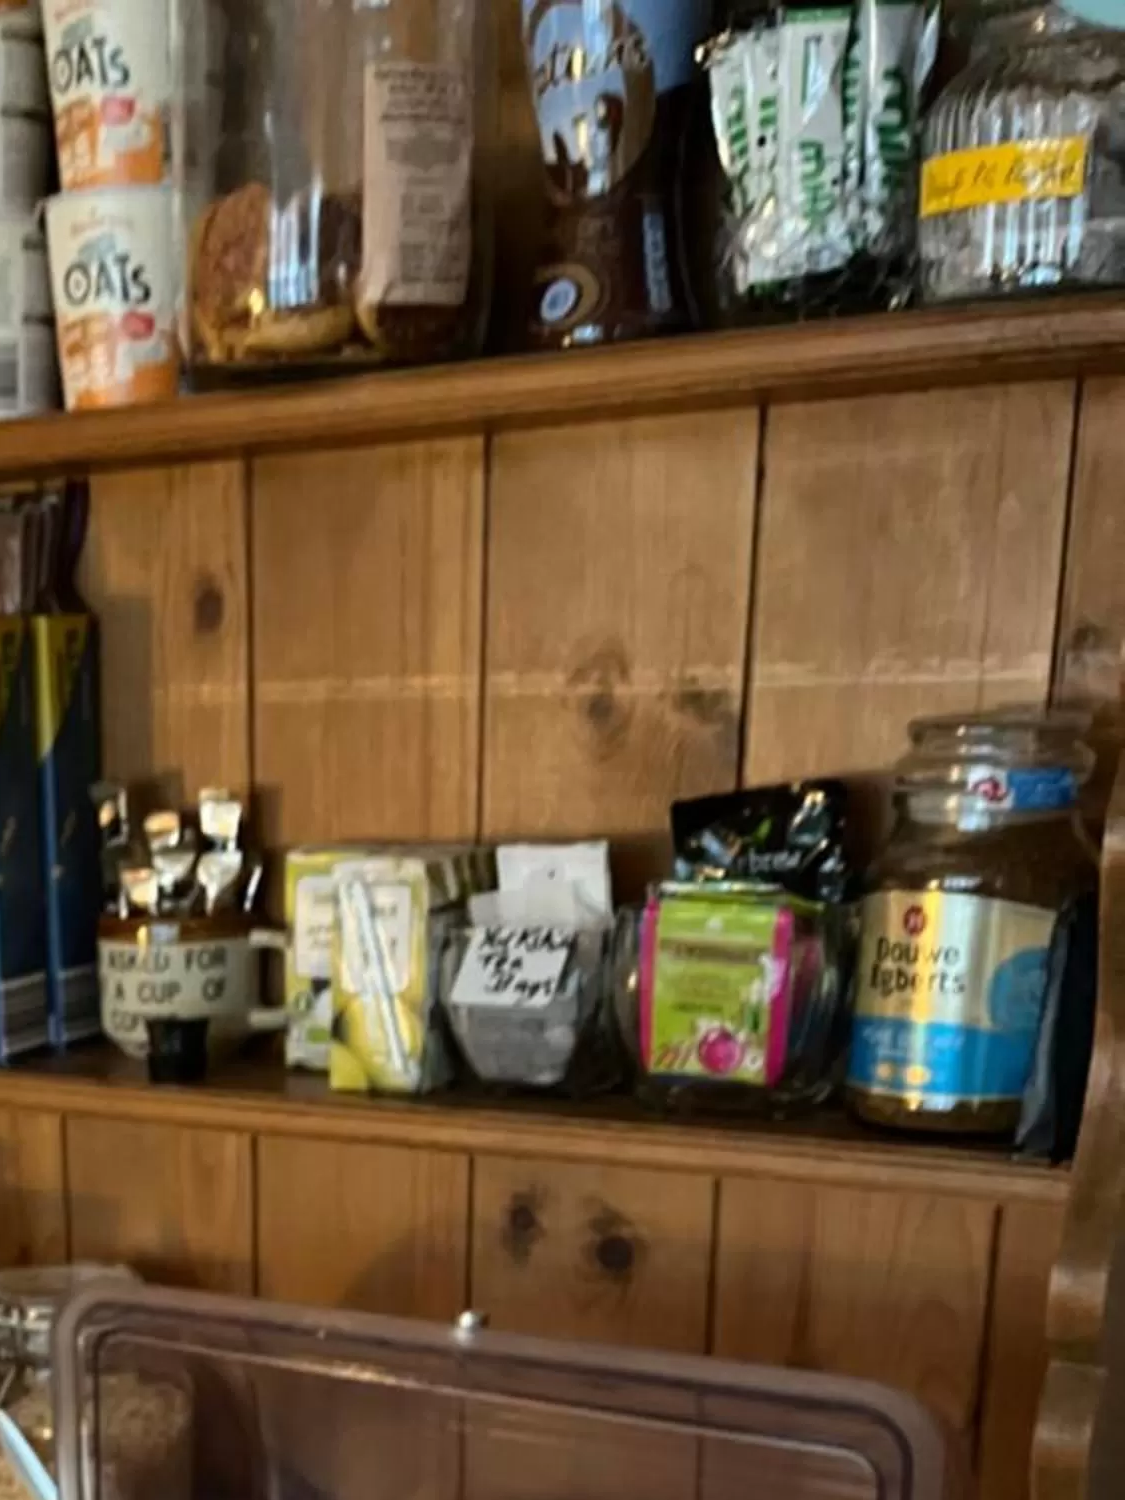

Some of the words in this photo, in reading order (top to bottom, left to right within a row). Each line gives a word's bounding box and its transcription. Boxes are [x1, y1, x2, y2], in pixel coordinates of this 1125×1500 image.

[108, 950, 171, 973] ASKD
[876, 937, 962, 966] Douwe
[137, 979, 182, 1005] CUP
[869, 961, 968, 998] Egberts
